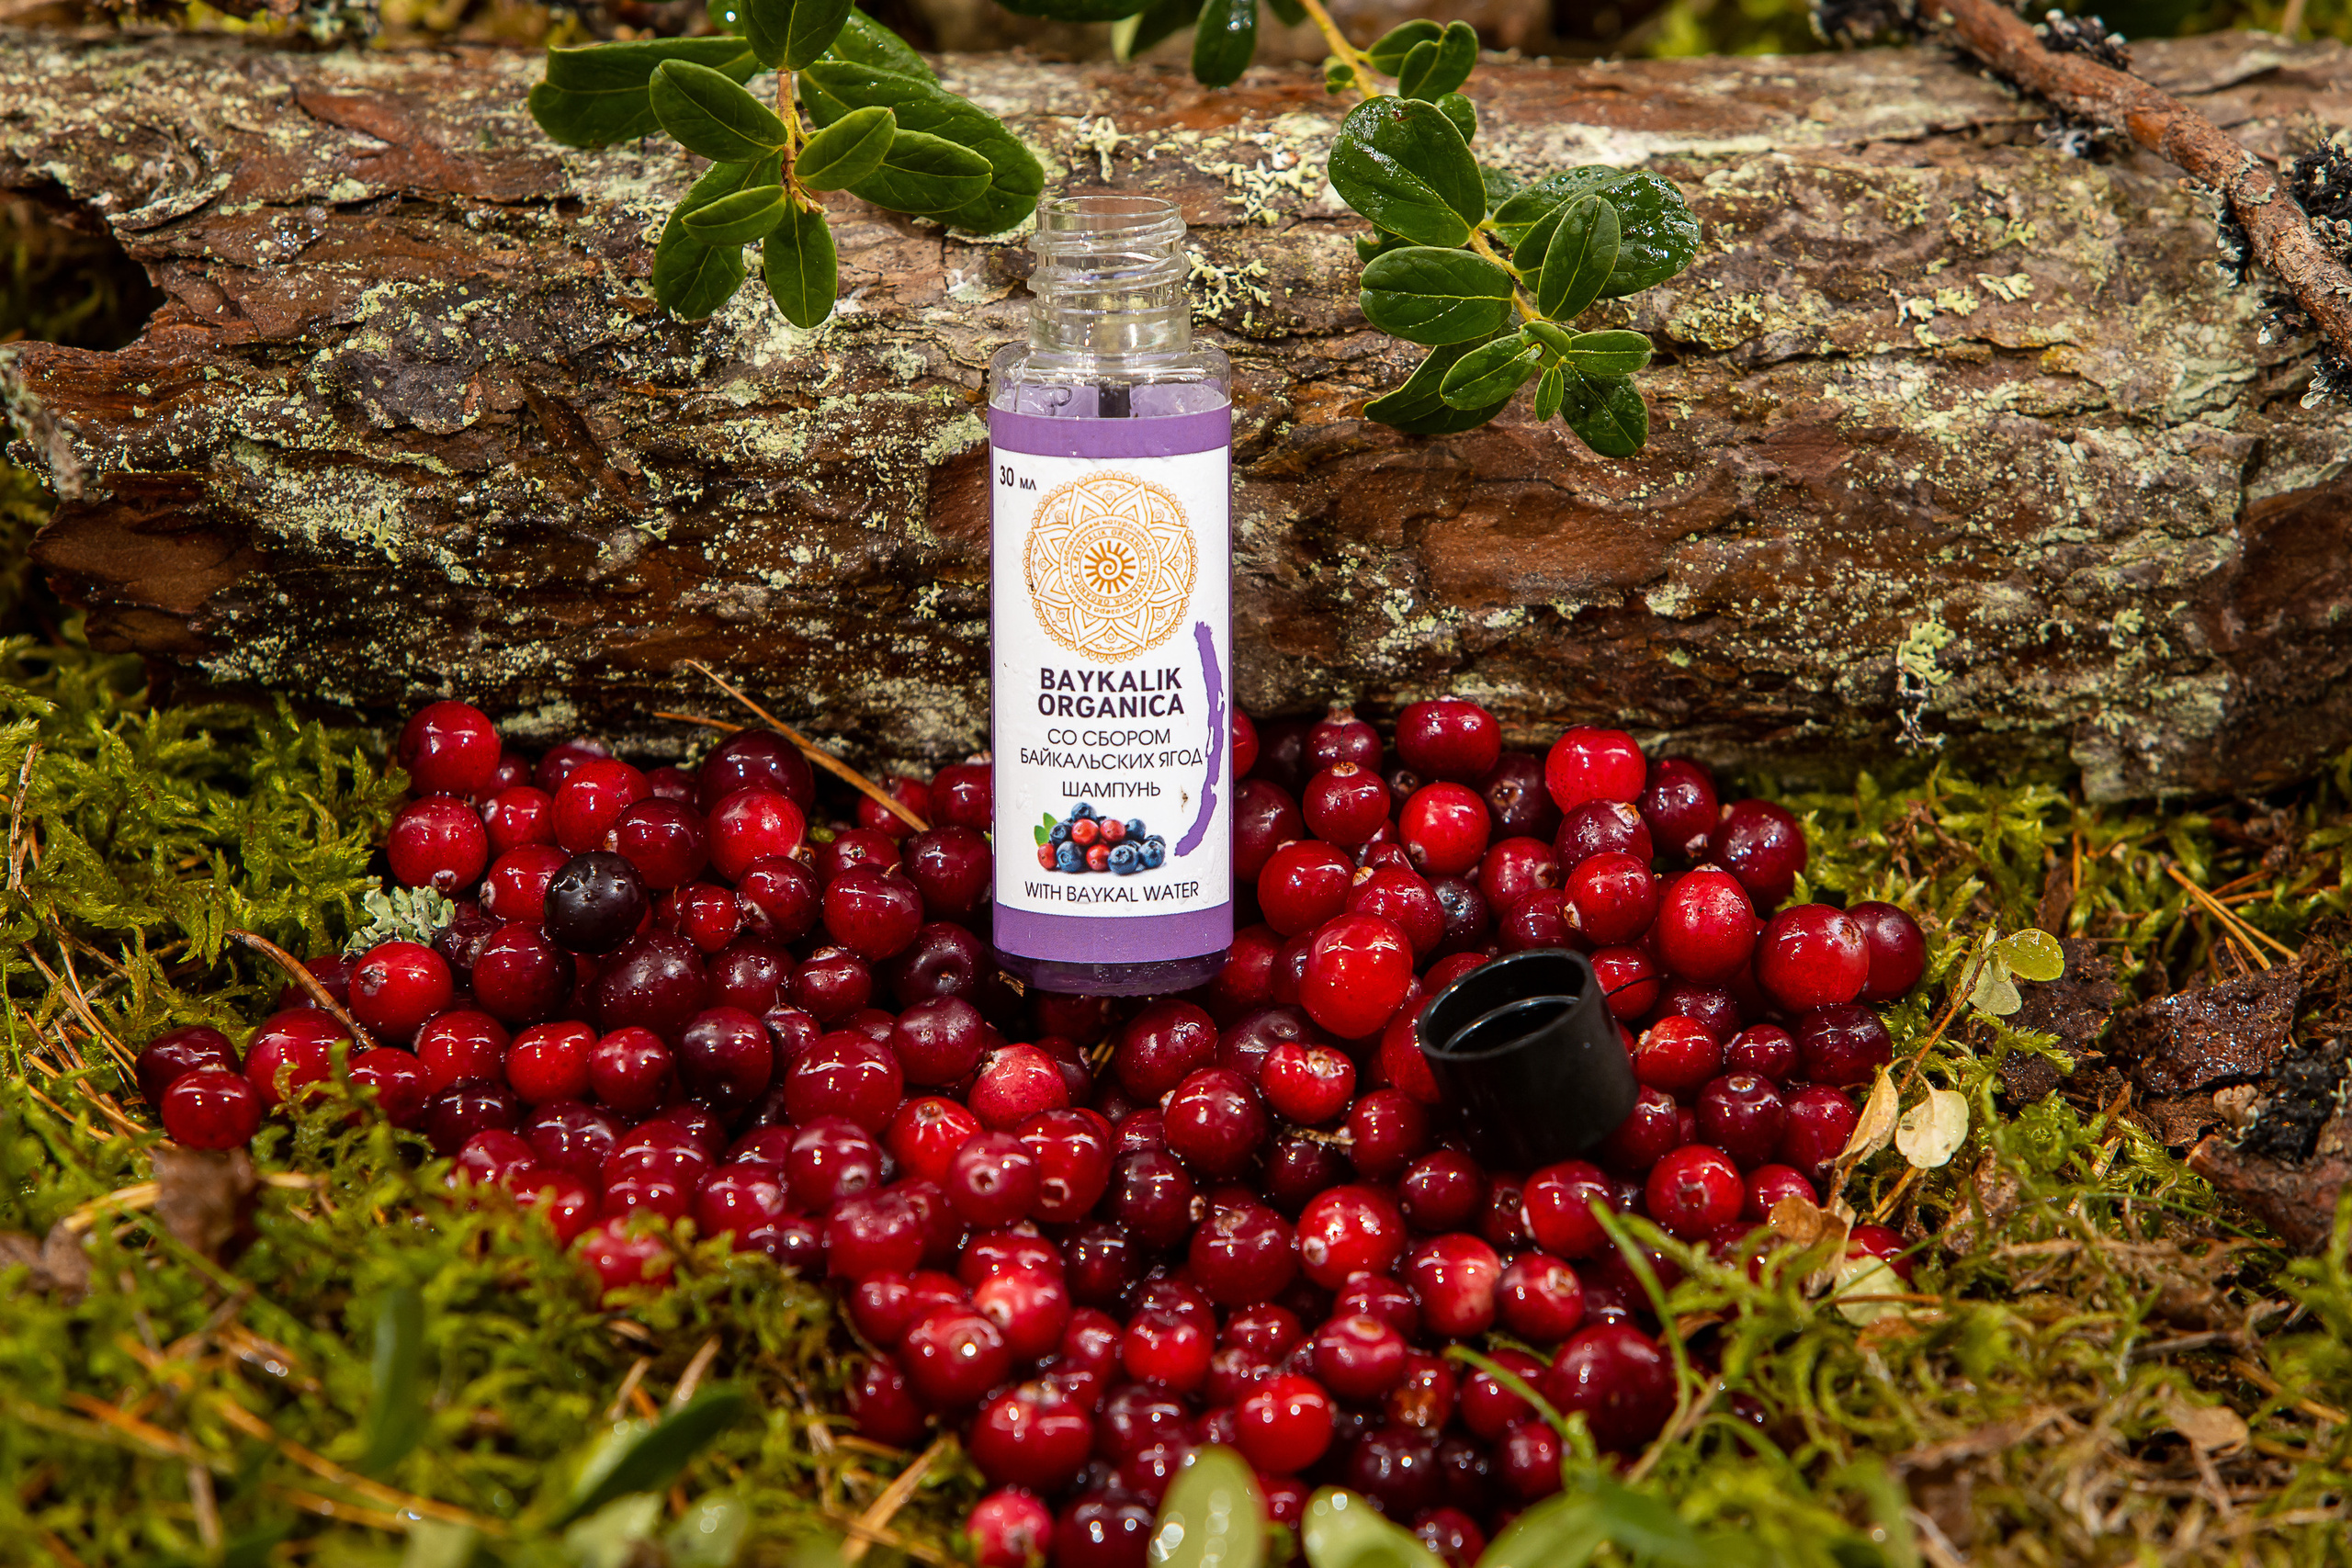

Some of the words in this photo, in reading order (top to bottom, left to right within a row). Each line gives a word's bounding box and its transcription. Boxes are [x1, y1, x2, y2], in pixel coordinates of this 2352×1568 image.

[1000, 465, 1014, 487] 30
[1072, 530, 1106, 561] BAYKALIK
[1111, 529, 1147, 560] ORGANICA
[1073, 573, 1110, 605] ORGANICA
[1114, 571, 1148, 604] BAYKALIK
[1040, 667, 1182, 693] BAYKALIK
[1037, 694, 1185, 718] ORGANICA
[1047, 728, 1078, 745] СО
[1082, 728, 1170, 746] СБОРОМ
[1020, 747, 1155, 770] БАЙКАЛЬСКИХ
[1159, 748, 1204, 768] ЯГОД
[1062, 781, 1161, 798] ШАМПУНЬ
[1024, 881, 1062, 900] WITH
[1067, 886, 1139, 903] BAYKAL
[1143, 881, 1199, 901] WATER
